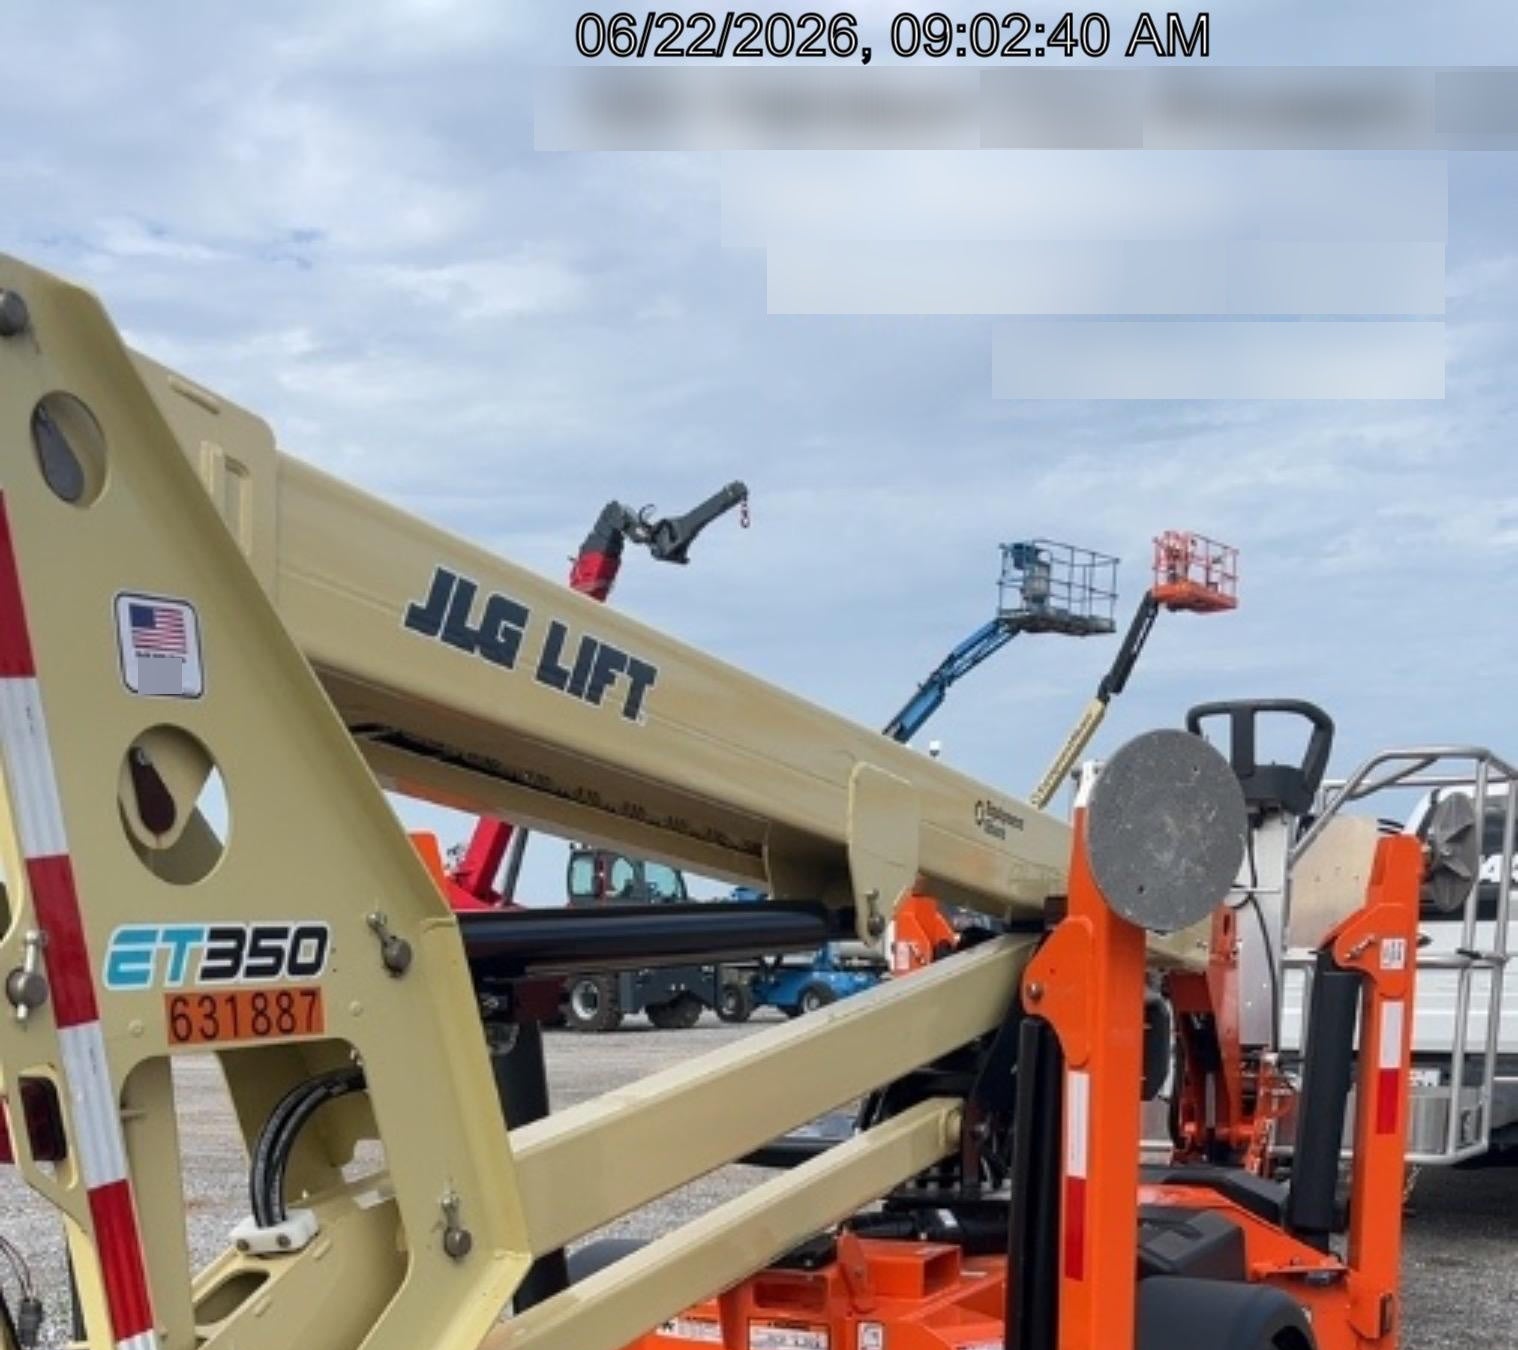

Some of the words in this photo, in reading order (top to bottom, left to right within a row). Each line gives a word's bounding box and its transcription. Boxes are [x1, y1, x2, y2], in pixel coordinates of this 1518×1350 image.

[404, 567, 530, 671] JLG
[535, 620, 658, 721] LIFT
[103, 921, 330, 989] ET350
[171, 991, 318, 1042] 631887
